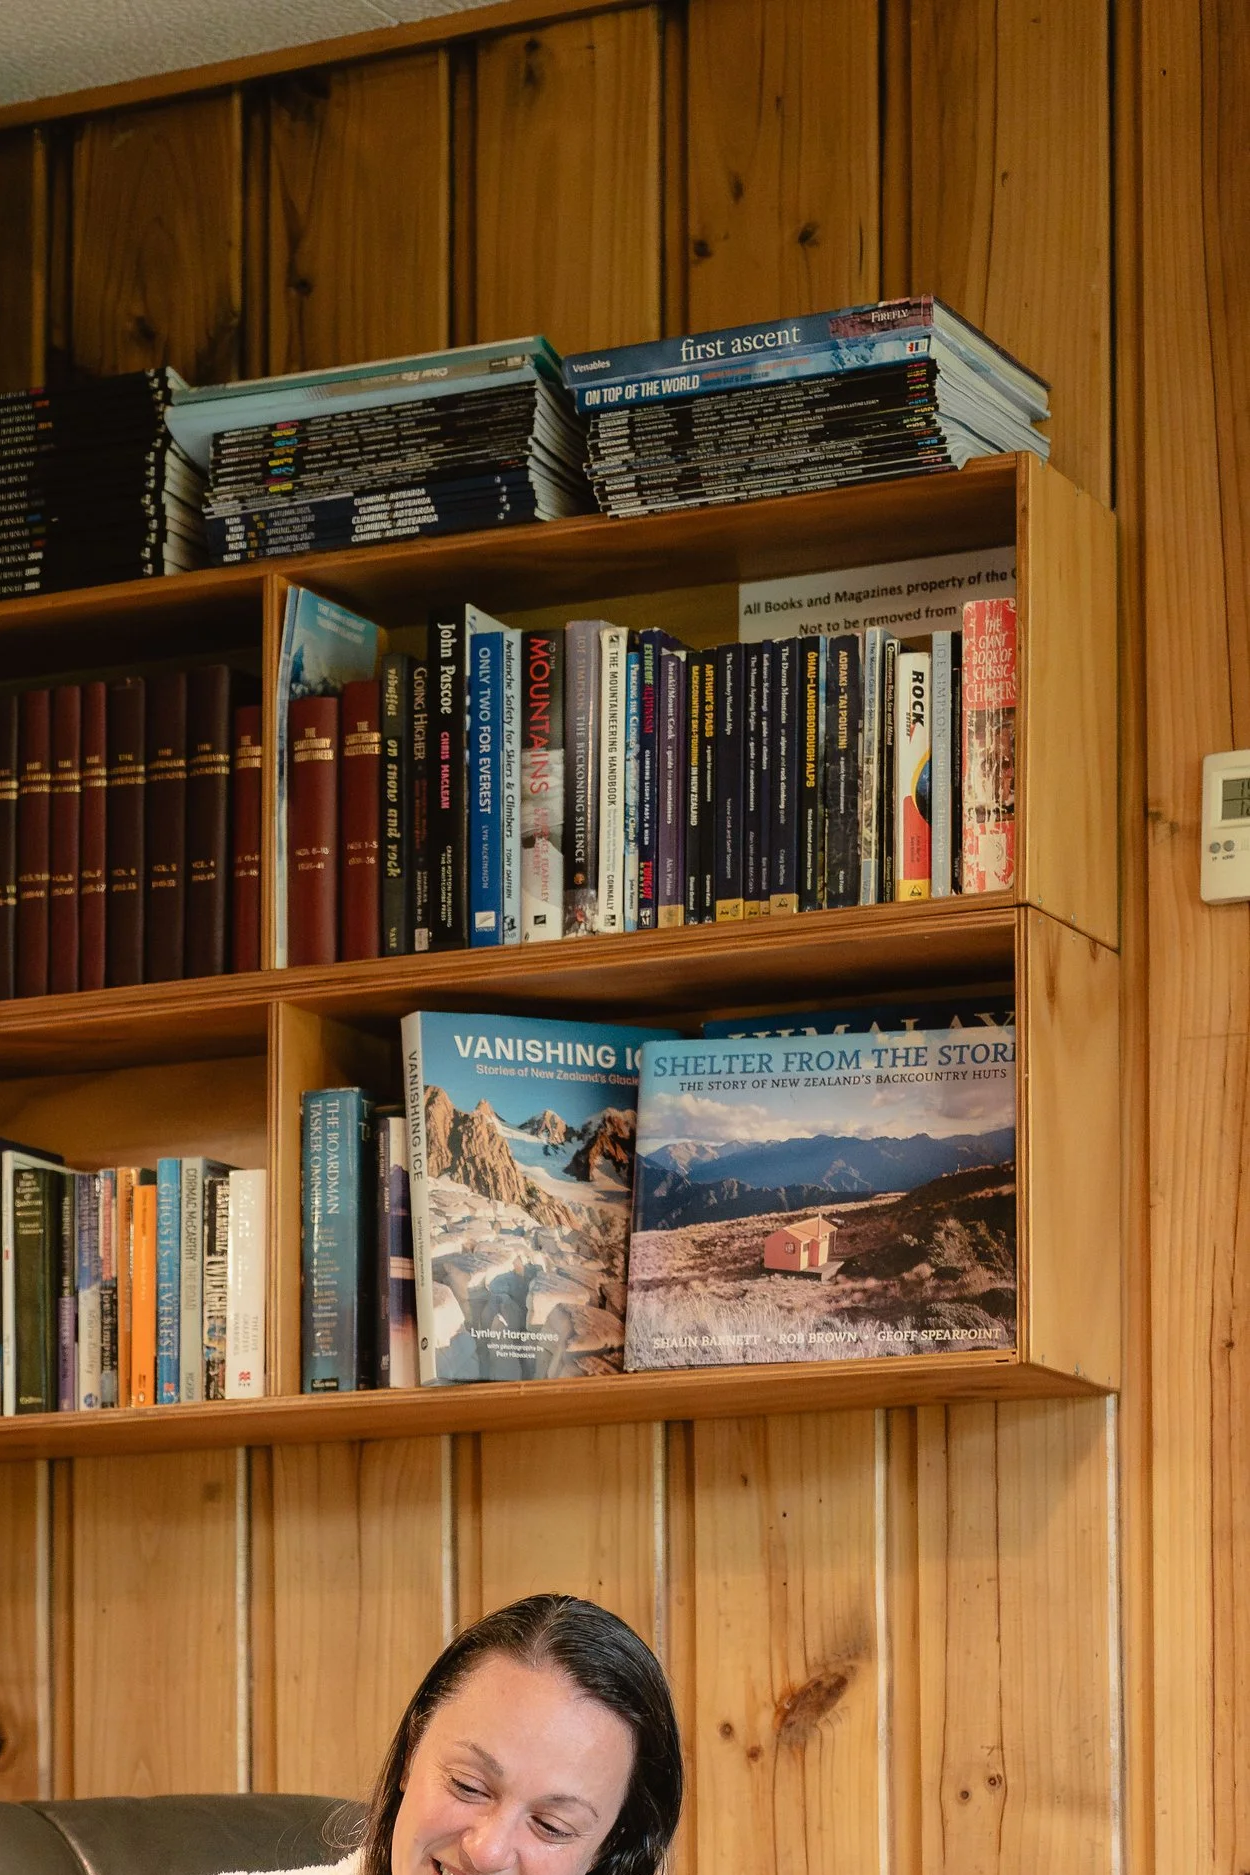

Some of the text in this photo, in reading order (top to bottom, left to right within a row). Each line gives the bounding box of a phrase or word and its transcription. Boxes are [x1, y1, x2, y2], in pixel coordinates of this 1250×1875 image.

[572, 359, 611, 374] Venables
[679, 325, 801, 363] first ascent
[585, 374, 700, 406] ON TOP OF THE WORLD
[744, 569, 1008, 616] All Books and Magazines property of the
[800, 604, 957, 636] Not to be removed from
[978, 631, 1008, 649] GIANT
[984, 615, 1002, 633] THE
[437, 622, 456, 714] John Pascoe
[609, 652, 618, 668] THE
[643, 644, 654, 685] EXTREME
[935, 642, 946, 672] JOE
[972, 649, 999, 664] BOOK
[976, 664, 1010, 680] CLASSIC
[412, 666, 428, 710] GOING
[667, 661, 676, 740] Aoraki/Mount Cook
[691, 665, 700, 718] BACKCOUNTRY
[704, 664, 714, 738] ARTHUR'S PASS
[780, 647, 788, 724] The Darran Mountains
[838, 650, 848, 749] AORAKI TAI POUTINI
[912, 670, 924, 727] ROCK
[935, 678, 946, 738] SIMPSON
[478, 647, 492, 814] ONLY TWO FOR EVEREST
[529, 637, 550, 795] MOUNTAINS
[608, 671, 618, 754] MOUNTAINEERING
[413, 713, 428, 760] HIGHER
[502, 640, 514, 838] Avalanche Safety for Skiers & Climbers
[440, 731, 451, 810] CHRIS MACLEAN
[575, 715, 586, 864] THE BECKONING SILENCE
[607, 756, 617, 806] HANDBOOK
[690, 775, 698, 792] NEW
[778, 736, 786, 809] alpine climbing
[805, 762, 816, 788] ALPS
[386, 739, 401, 878] on snow and rock
[690, 794, 698, 826] ZEALAND
[606, 874, 616, 910] CONNALLY
[454, 1036, 616, 1070] VANISHING
[476, 1064, 606, 1085] Stories of New Zealand's
[654, 1051, 774, 1078] SHELTER
[782, 1048, 862, 1072] FROM
[872, 1046, 928, 1068] THE
[938, 1042, 1016, 1066] STOR
[680, 1068, 1007, 1092] THE STORY OF NEW ZEALAND'S BACKCOUNTRY HUTS
[408, 1050, 424, 1182] VANISHING ICE
[308, 1100, 324, 1224] TASKER OMNIBUS
[326, 1100, 340, 1214] THE BOARDMAN
[184, 1168, 198, 1262] CORMAC McCARTHY
[158, 1182, 174, 1358] GHOSTS EVEREST
[470, 1328, 558, 1342] Lynley Hargreaves
[654, 1326, 1002, 1350] SHAUN BARNETT ROB BROWN GEOFF SPEARPOINT
